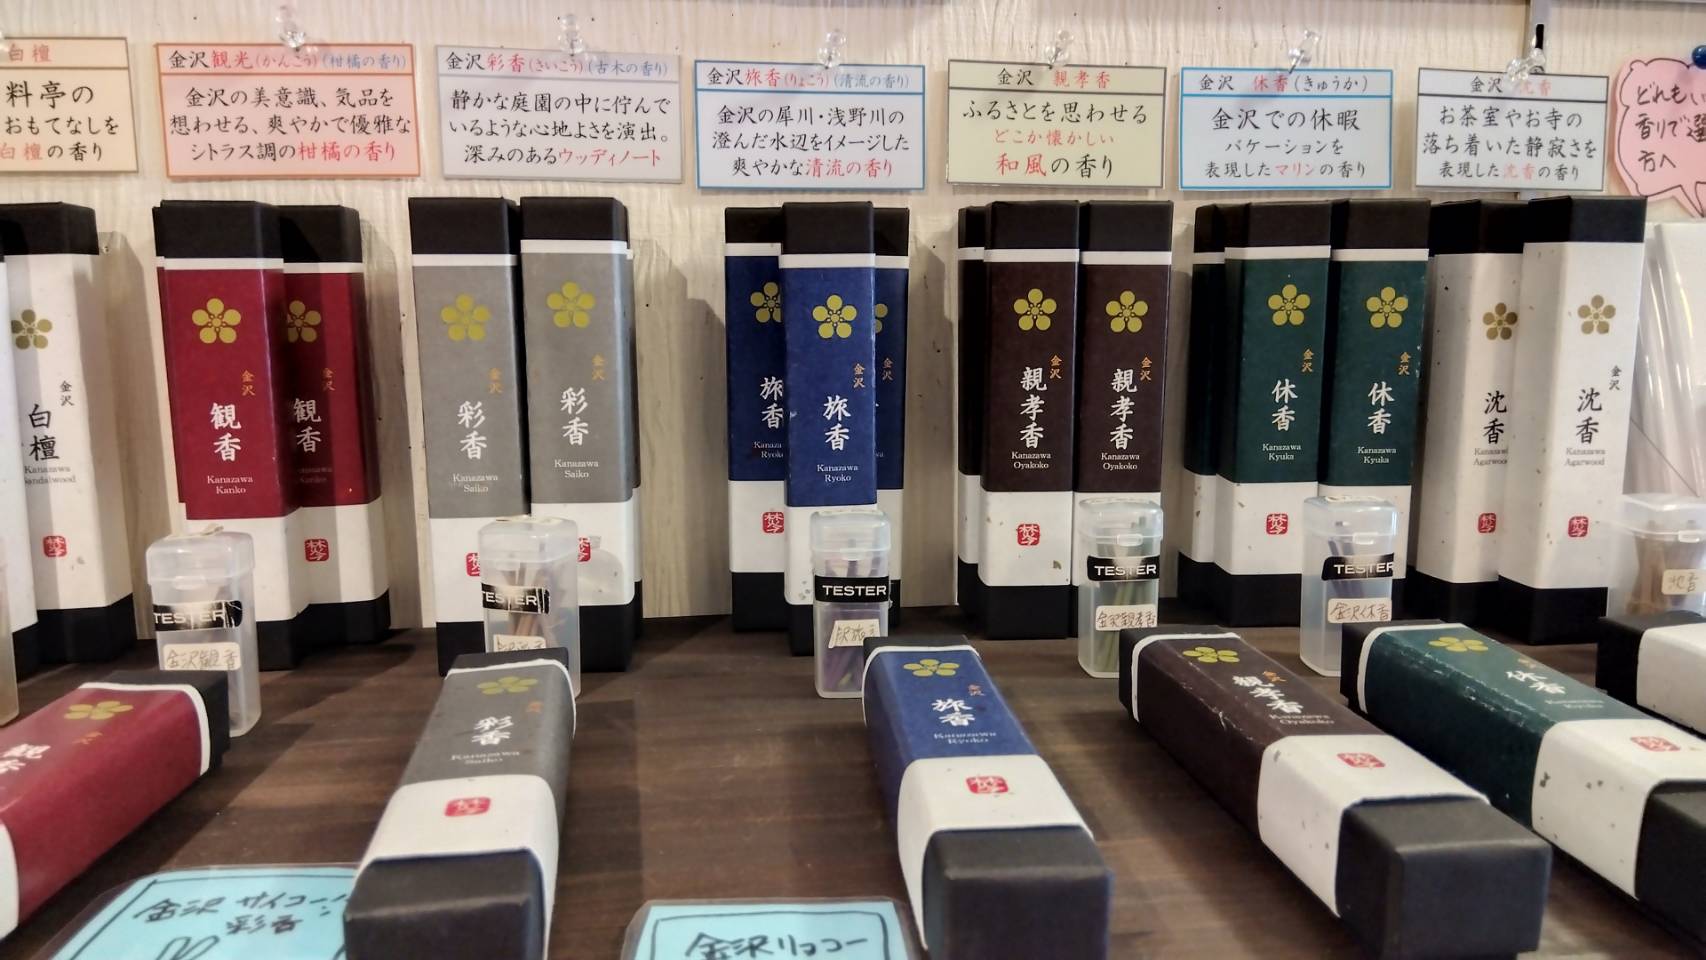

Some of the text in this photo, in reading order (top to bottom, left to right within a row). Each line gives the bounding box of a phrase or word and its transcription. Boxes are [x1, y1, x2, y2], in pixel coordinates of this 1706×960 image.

[8, 43, 52, 62] 白檀
[997, 68, 1111, 89] 金沢 親孝香
[1200, 74, 1234, 91] 金沢
[1470, 76, 1503, 93] 金沢
[5, 80, 94, 109] 料亭の
[185, 86, 394, 108] 金沢の美意識、気品を
[450, 89, 671, 115] 静かな庭園の中に佇んで
[717, 105, 904, 127] 金沢の犀川・浅野川の
[963, 100, 1147, 124] ふるさとを思わせる
[1212, 107, 1361, 131] 金沢での休暇
[1439, 105, 1582, 130] お茶室やお寺の
[4, 116, 119, 135] おもてなしを
[169, 114, 411, 135] 想わせる、爽やかで優雅な
[450, 119, 668, 143] いるような心地よさを演出。
[712, 131, 910, 151] 澄んだ水辺をイメージした
[994, 129, 1114, 146] どこか懐かしい
[1225, 139, 1344, 155] バケーションを
[1423, 132, 1597, 159] 落ち着いた静寂さを
[0, 142, 102, 162] 白檀の香り
[191, 141, 395, 162] シトラス調の柑橘の香り
[464, 145, 661, 167] 深みのあるウッディノート
[1638, 150, 1676, 172] 方へ
[732, 157, 892, 177] 爽やかな清流の香り
[997, 153, 1113, 179] 和風の香り
[1205, 161, 1366, 178] 表現したマリンの香り
[1049, 355, 1062, 379] 金沢
[1140, 356, 1152, 381] 金沢
[1302, 349, 1314, 373] 金沢
[1398, 351, 1411, 375] 金沢
[241, 370, 255, 396] 金沢
[853, 363, 866, 388] 金沢
[1609, 365, 1622, 390] 金沢
[60, 380, 75, 406] 金沢
[560, 386, 589, 446] 彩香
[1020, 366, 1047, 449] 親孝香
[1110, 368, 1138, 450] 親孝香
[1271, 378, 1298, 432] 休香
[1367, 381, 1395, 435] 休香
[1576, 387, 1602, 444] 沈香
[293, 397, 322, 453] 観香
[823, 394, 851, 450] 旅香
[1483, 390, 1508, 444] 沈香
[28, 403, 60, 461] 白檀
[209, 402, 242, 462] 観香
[457, 400, 487, 460] 彩香
[753, 441, 782, 449] Kanaza
[1011, 451, 1051, 459] Kanazawa
[1262, 443, 1301, 451] Kanazawa
[1357, 446, 1396, 454] Kanazawa
[554, 459, 599, 468] Kanazawa
[817, 464, 859, 472] Kanazawa
[1013, 461, 1049, 469] Oyakoko
[1103, 462, 1138, 471] Oyakoko
[1269, 453, 1294, 461] Kyuka
[1363, 456, 1389, 464] Kyuka
[207, 475, 253, 483] Kanazawa
[452, 473, 498, 481] Kanazawa
[564, 470, 589, 478] Saiko
[825, 474, 851, 483] Ryoko
[216, 486, 246, 494] Kanko
[463, 484, 489, 493] Saiko
[1094, 564, 1157, 576] TESTER
[822, 585, 887, 596] TESTER
[931, 698, 975, 727] 旅香
[471, 715, 514, 746] 彩香
